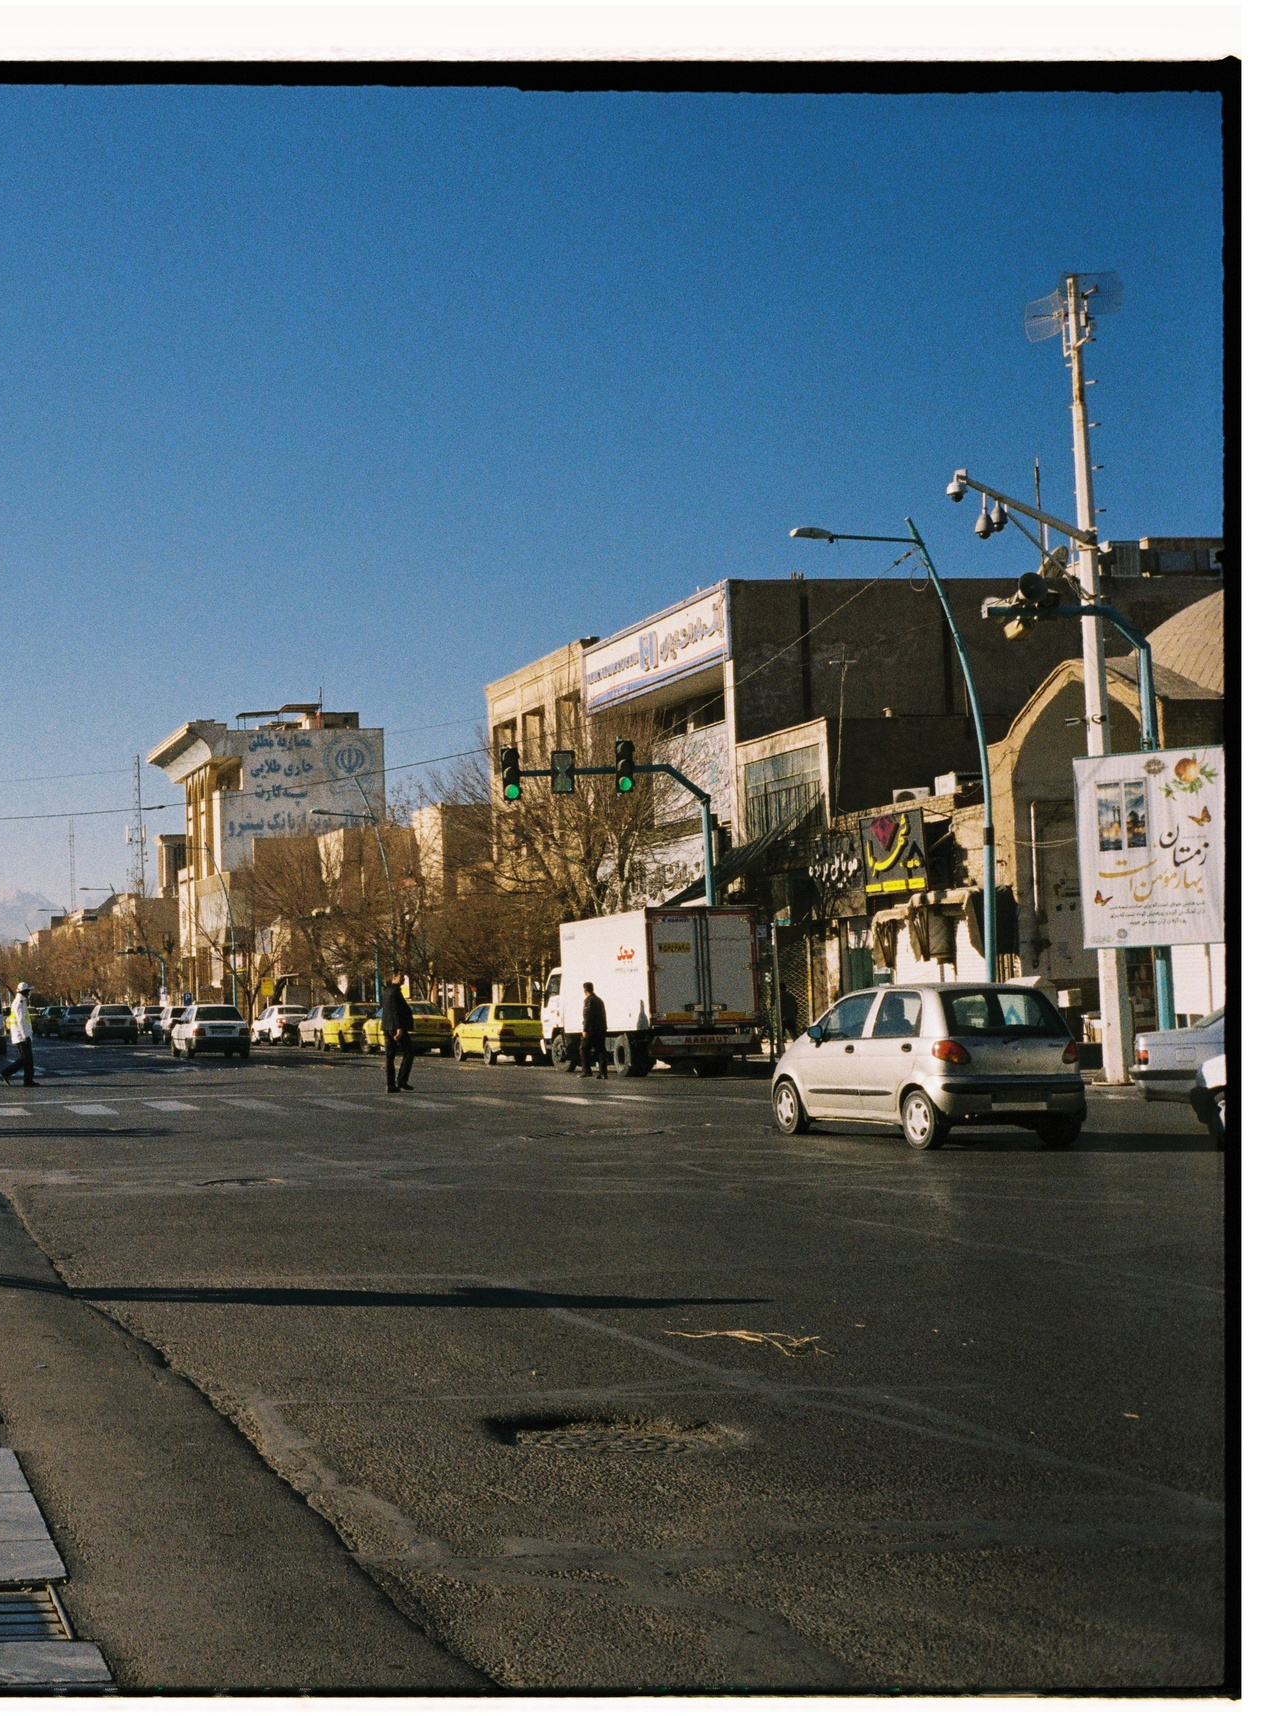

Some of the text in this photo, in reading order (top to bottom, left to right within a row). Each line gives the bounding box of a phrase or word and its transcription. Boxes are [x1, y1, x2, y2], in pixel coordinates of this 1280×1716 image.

[248, 733, 275, 752] مطلق
[250, 758, 313, 779] جاری طلایی
[254, 783, 283, 802] کارت
[1159, 823, 1210, 867] زمستان
[830, 852, 858, 888] موبایل
[1173, 868, 1204, 893] بهار
[685, 1035, 728, 1044] MAMMUT
